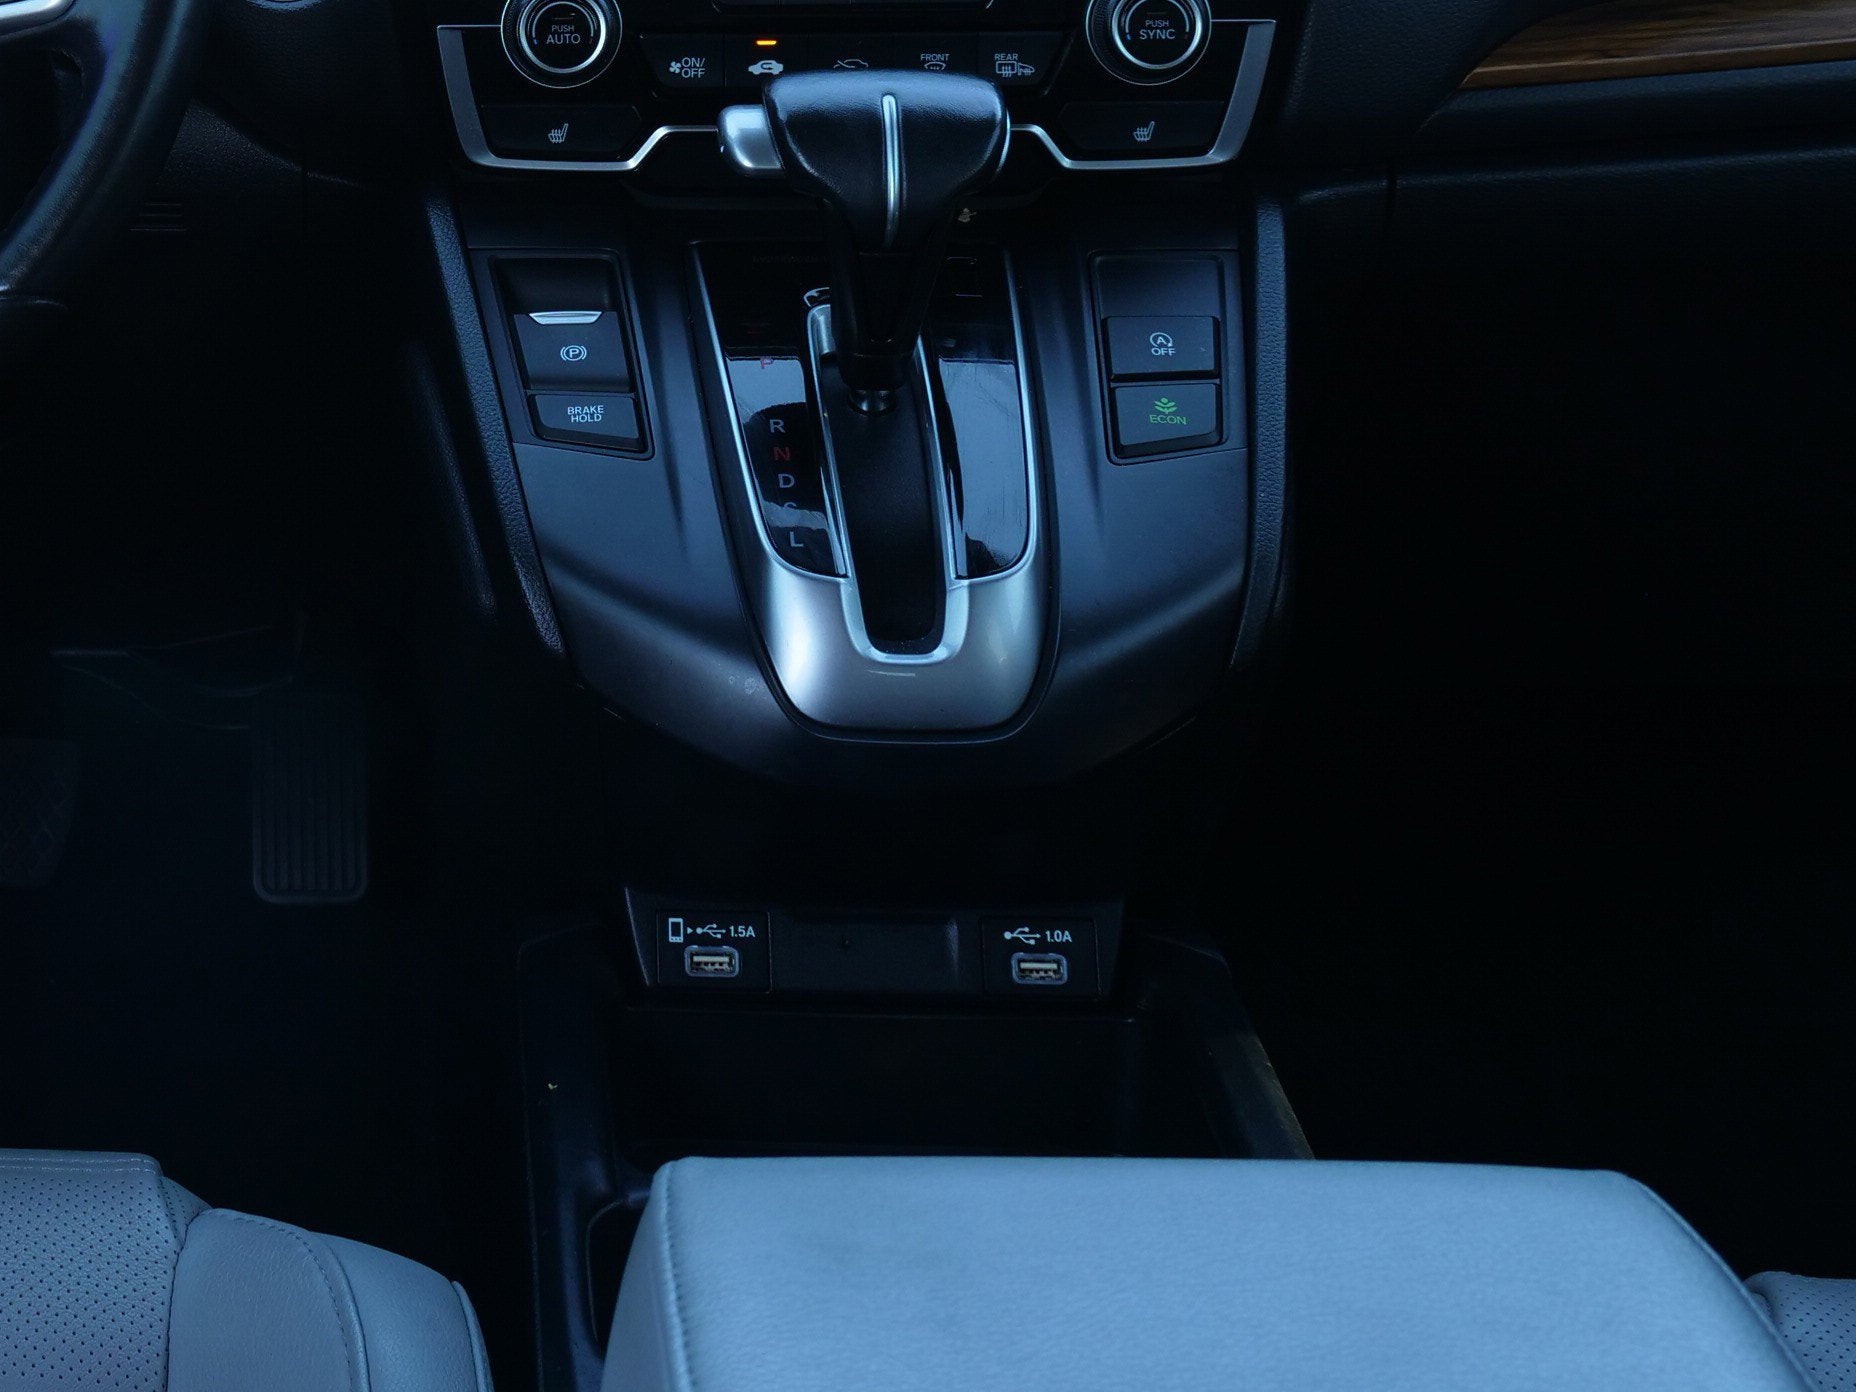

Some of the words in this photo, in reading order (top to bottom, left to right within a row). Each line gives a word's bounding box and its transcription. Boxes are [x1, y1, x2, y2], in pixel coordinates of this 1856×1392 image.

[551, 24, 575, 32] PUSH
[1145, 19, 1170, 27] PUSH
[546, 33, 581, 46] AUTO
[1138, 28, 1176, 40] SYNC
[681, 56, 706, 68] ON/
[920, 53, 950, 62] FRONT
[994, 53, 1019, 61] REAR
[681, 68, 706, 79] OFF
[1150, 346, 1176, 356] OFF
[567, 405, 605, 416] BRAKE
[570, 414, 603, 423] HOLD
[1149, 413, 1187, 425] ECON
[769, 419, 786, 433] R
[773, 446, 791, 460] N
[778, 473, 795, 488] D
[789, 531, 804, 548] L
[729, 924, 756, 939] 1.5A
[1045, 929, 1073, 943] 1.0A
